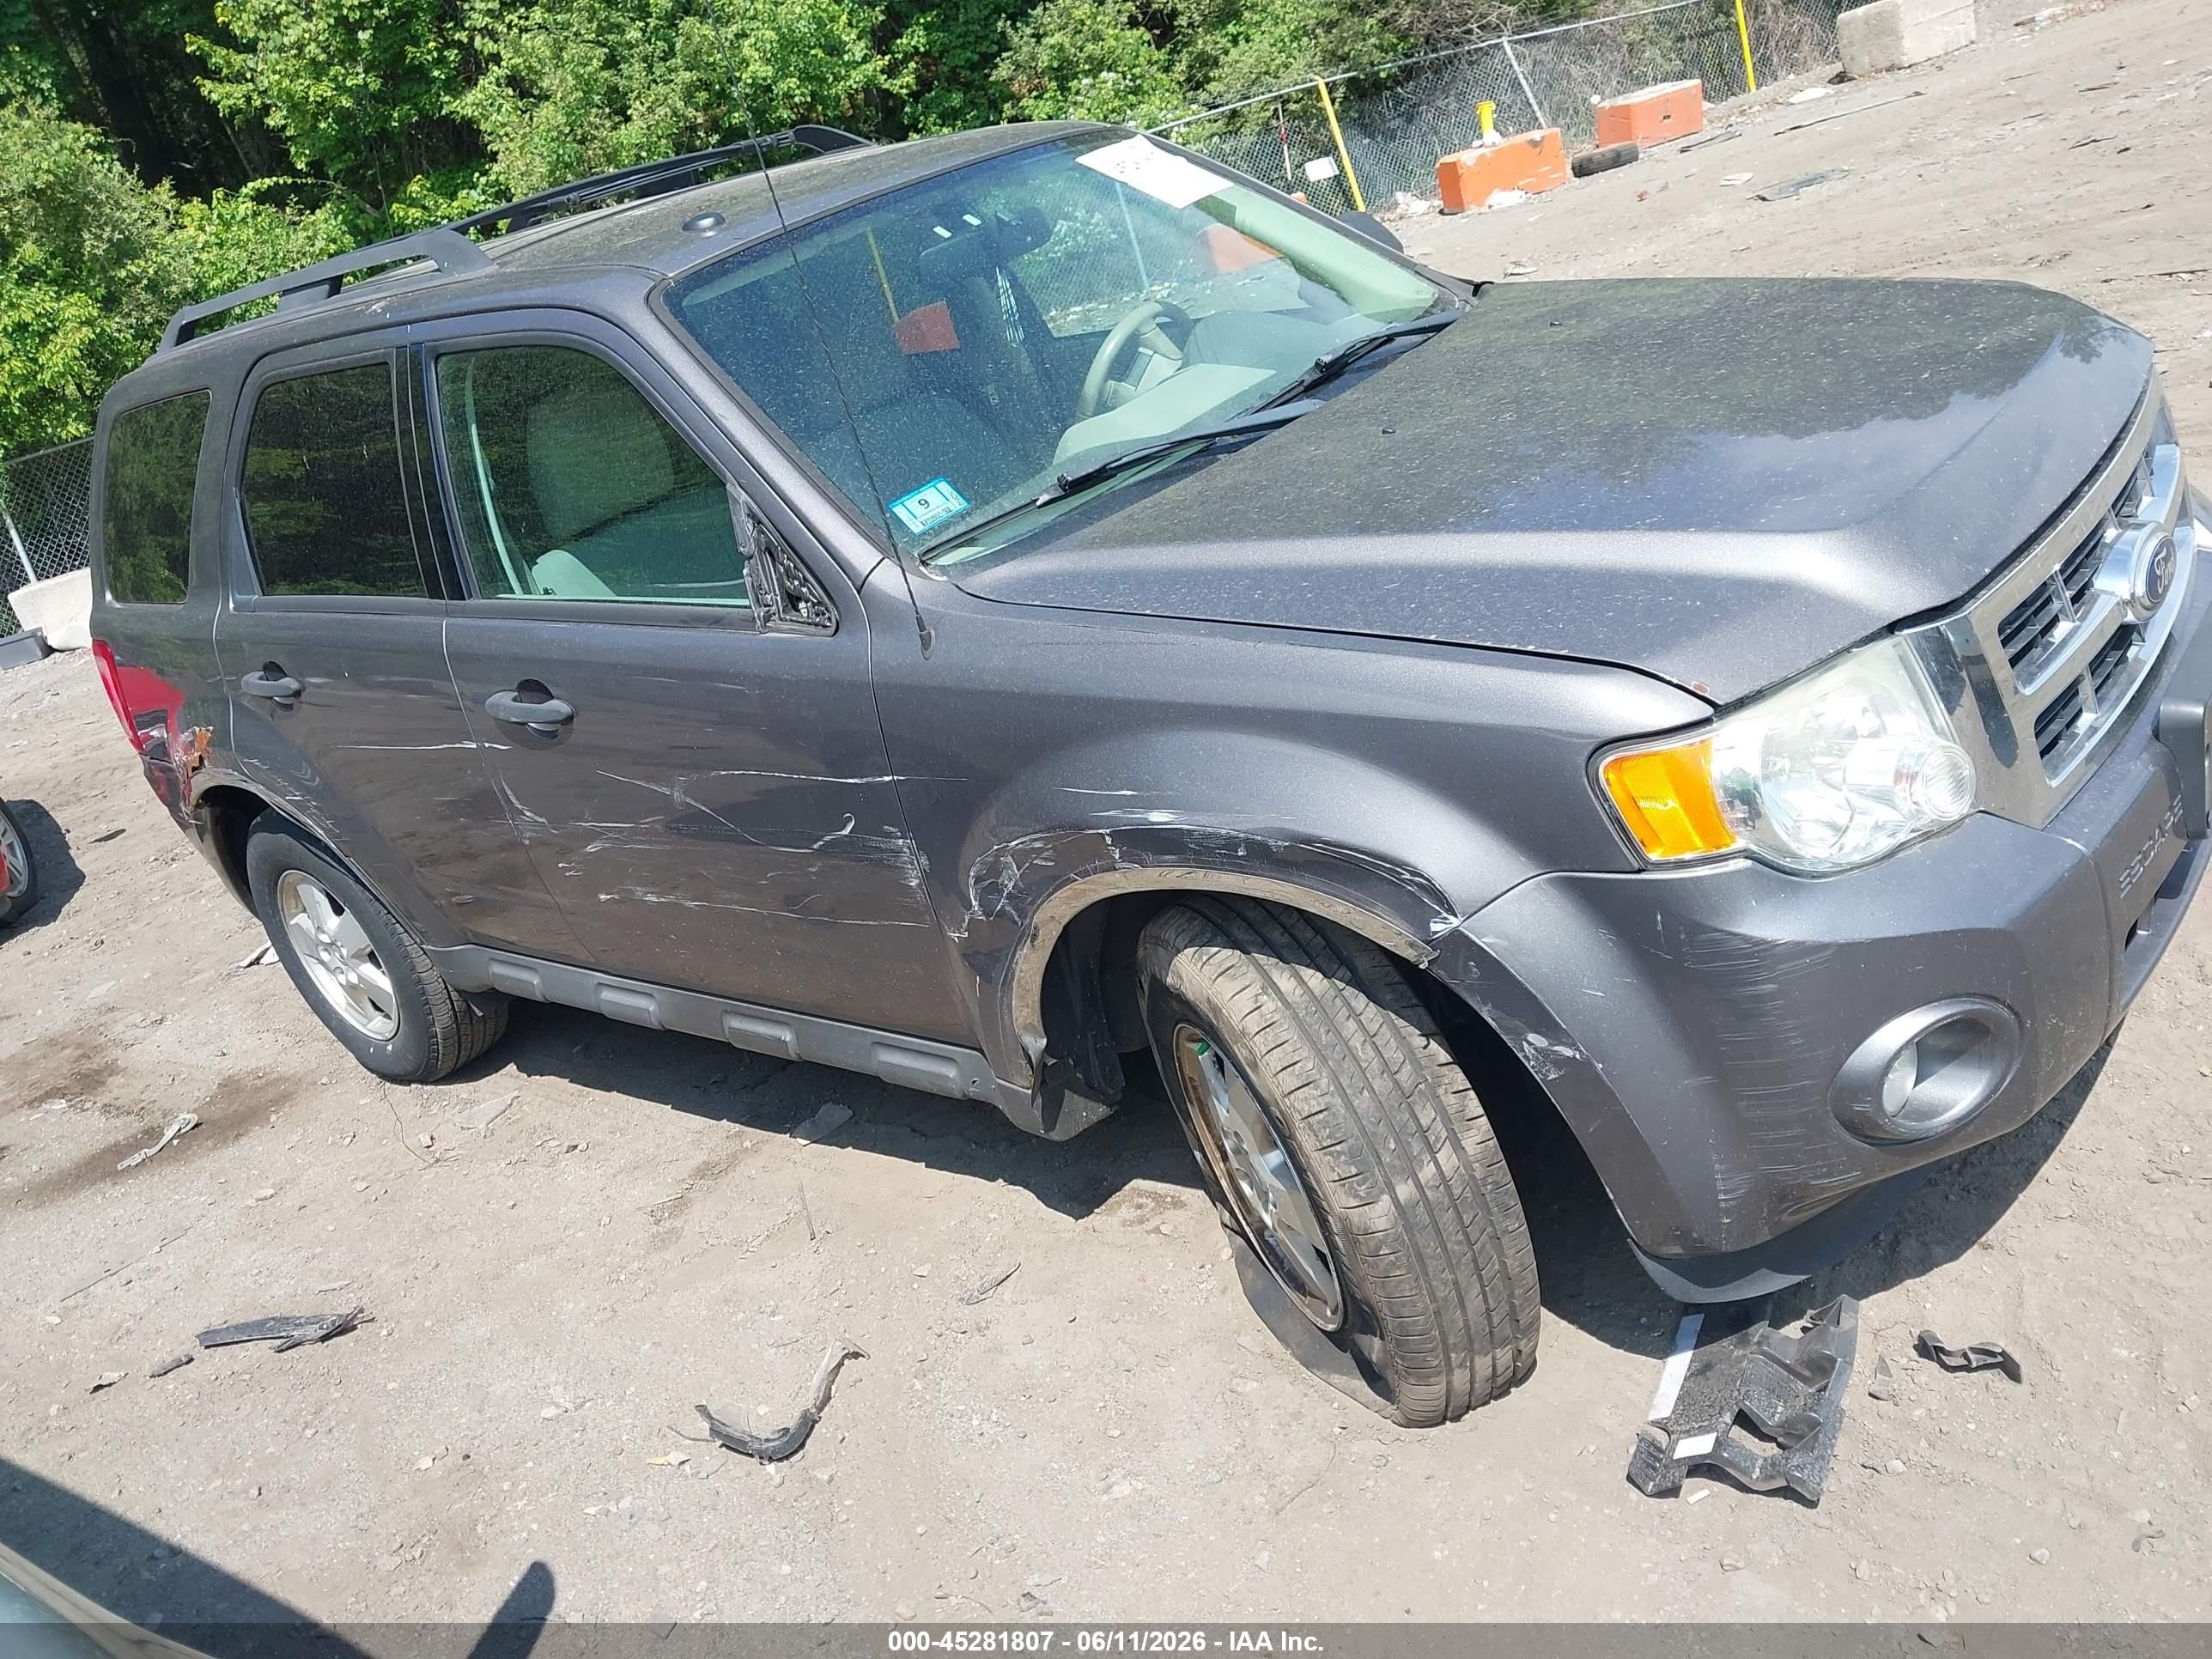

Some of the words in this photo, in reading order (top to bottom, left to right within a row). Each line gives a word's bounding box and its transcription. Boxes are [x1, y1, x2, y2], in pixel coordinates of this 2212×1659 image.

[918, 498, 930, 510] 9
[2153, 545, 2176, 595] Ford
[2118, 793, 2185, 900] ESCAPE
